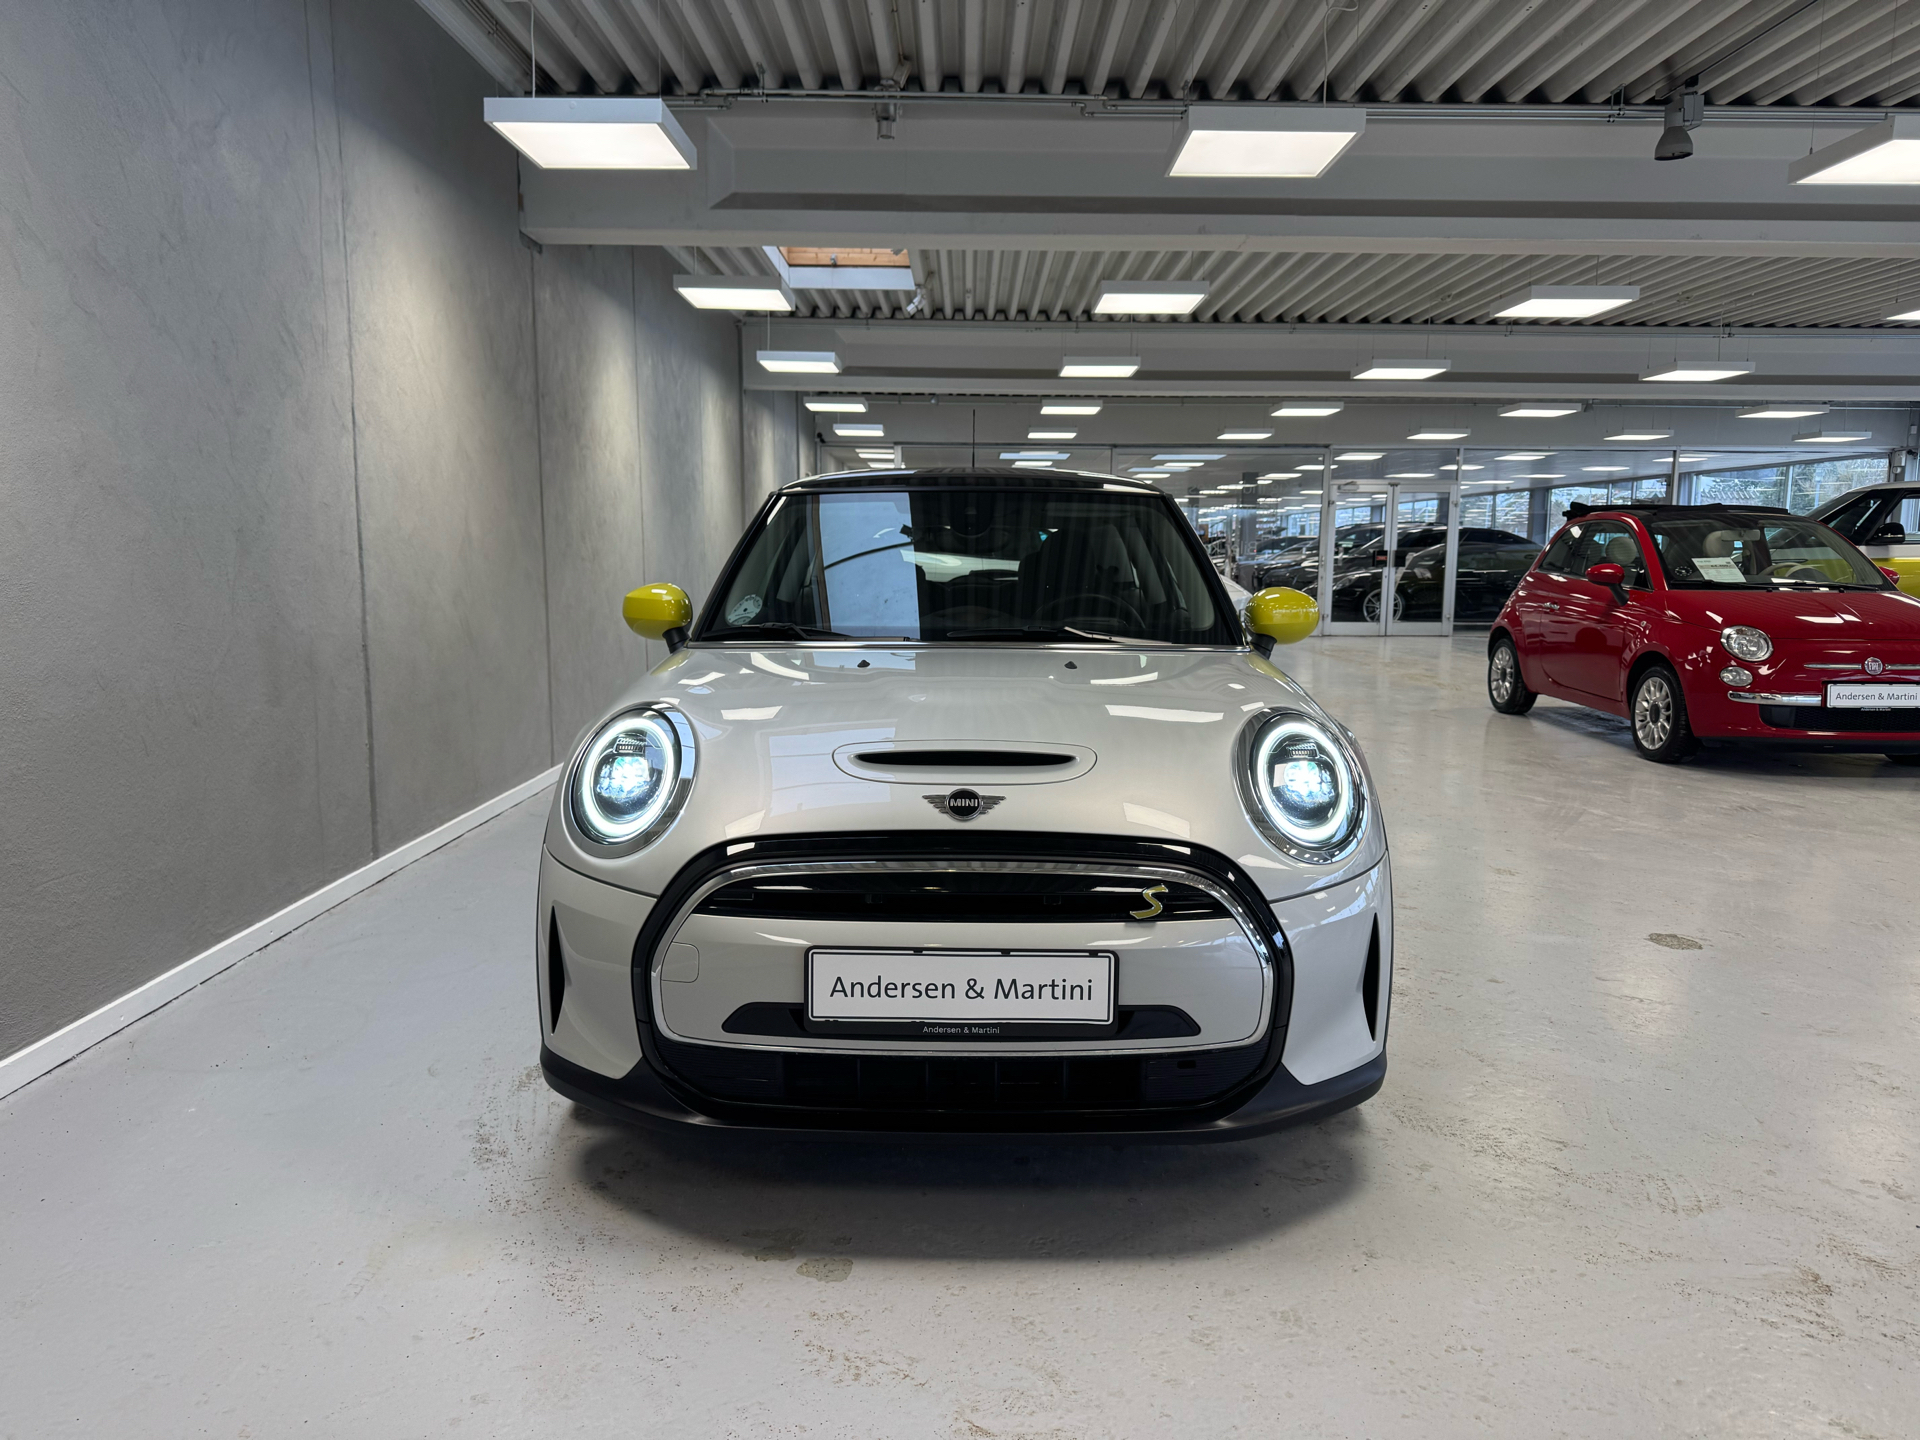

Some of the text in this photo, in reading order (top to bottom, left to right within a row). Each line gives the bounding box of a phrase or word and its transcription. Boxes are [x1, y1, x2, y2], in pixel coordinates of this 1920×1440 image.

[1835, 691, 1918, 701] Andersen & Martini
[949, 798, 979, 807] MINI
[1130, 883, 1169, 919] S
[829, 975, 1093, 1001] Andersen & Martini
[922, 1025, 1000, 1034] Andersen & Martini
